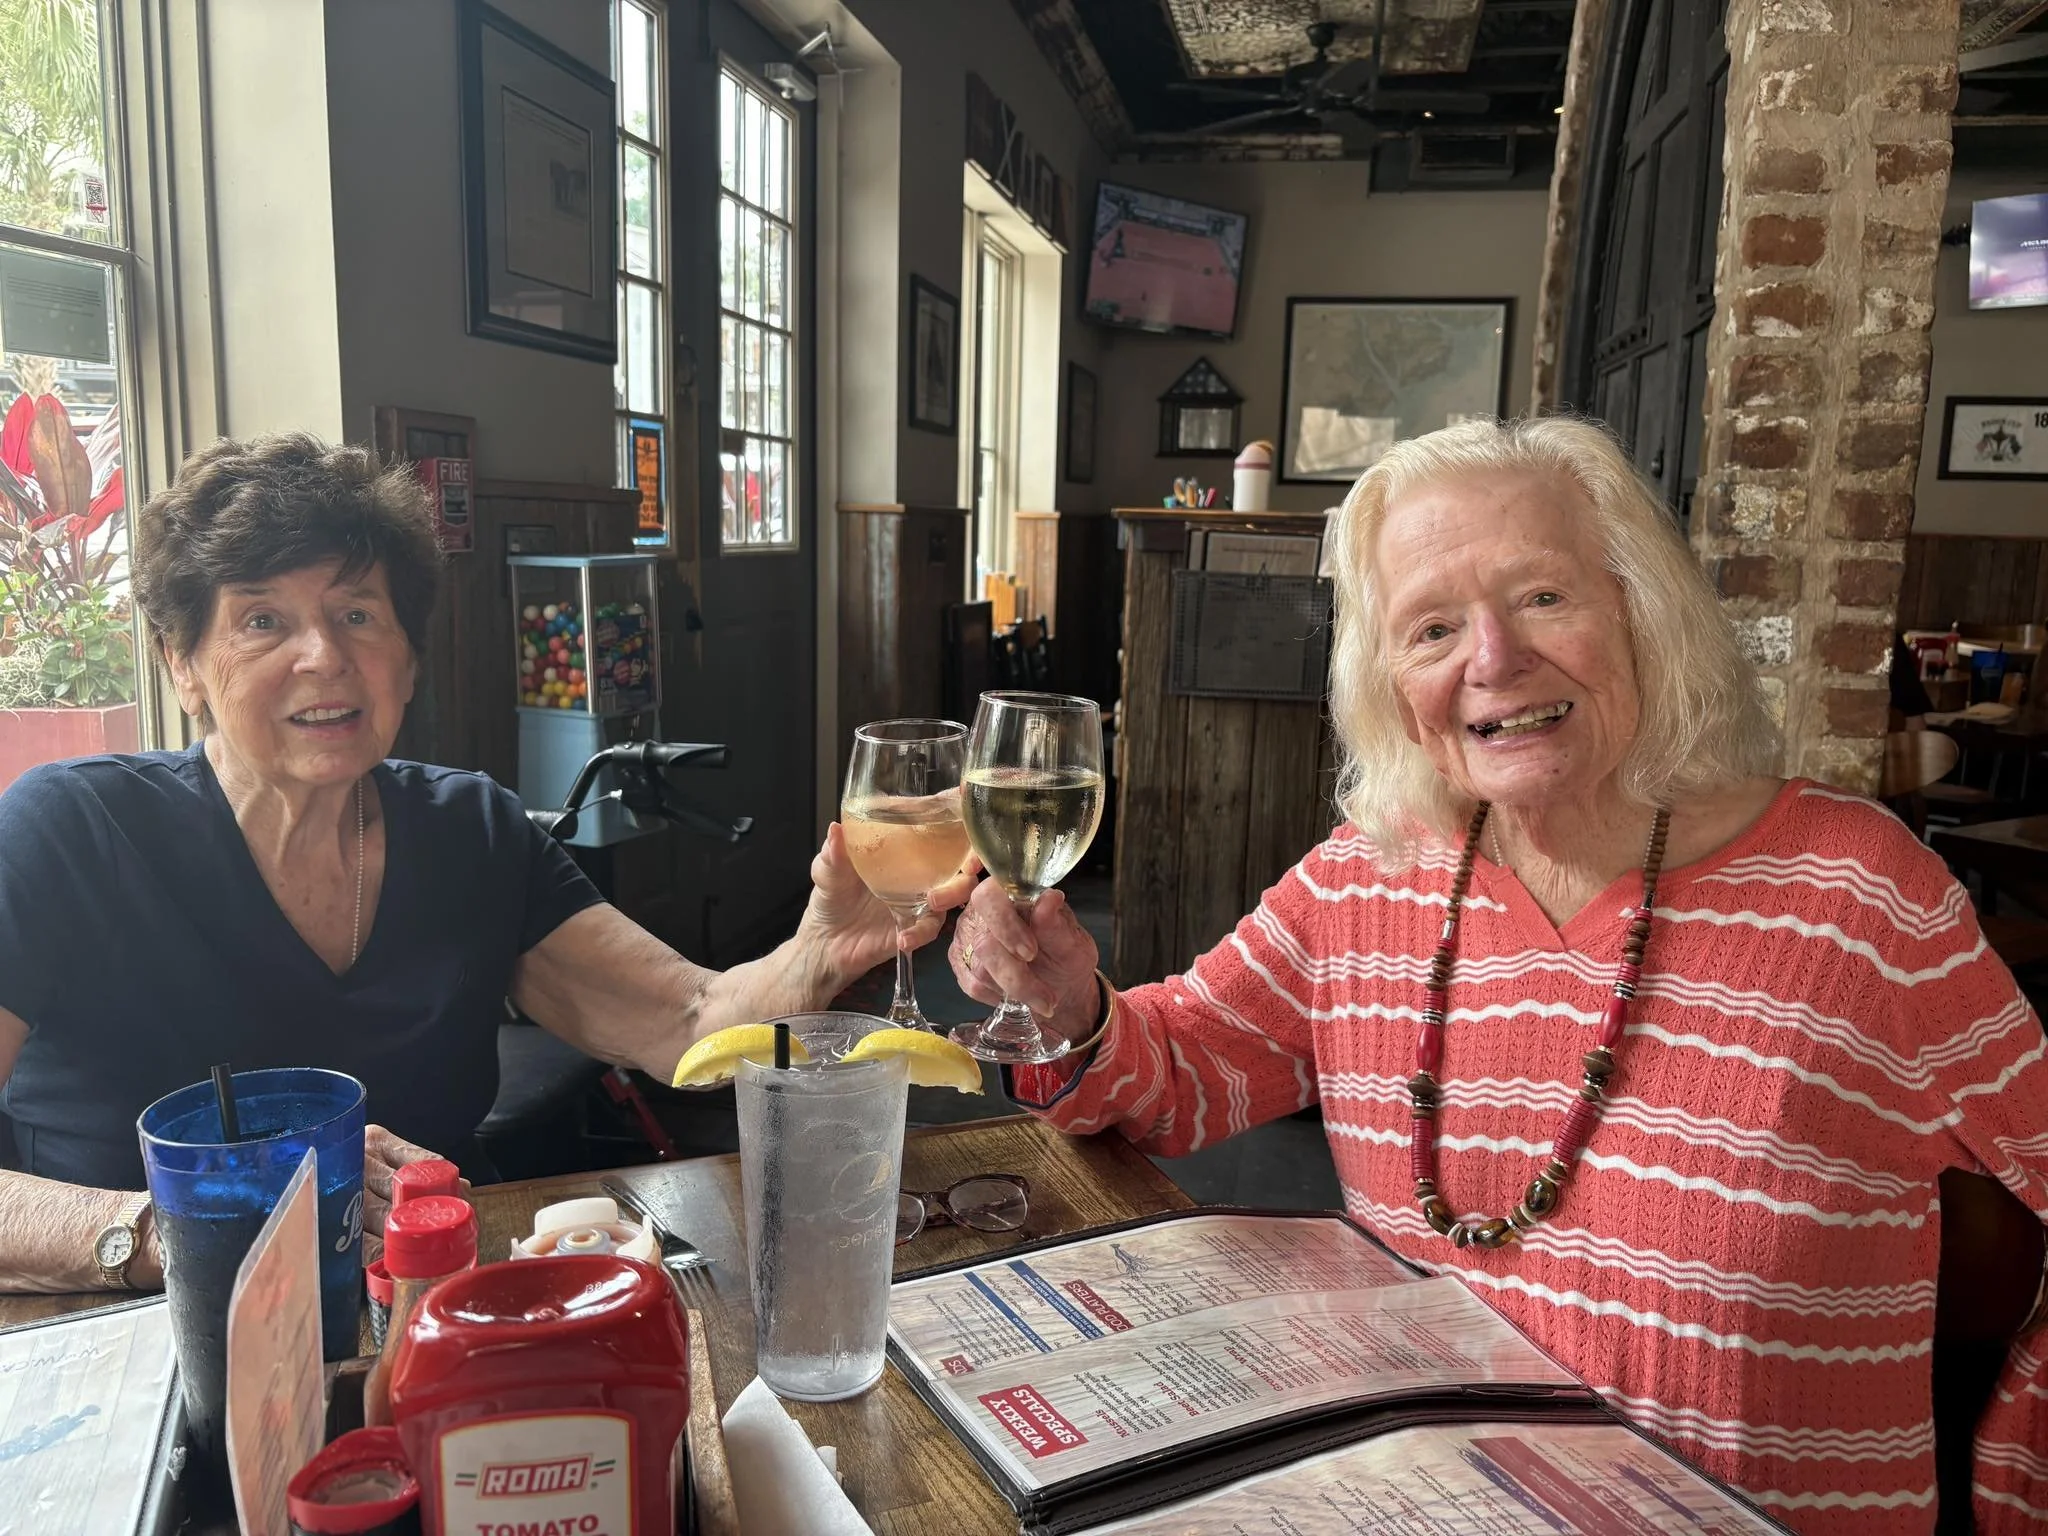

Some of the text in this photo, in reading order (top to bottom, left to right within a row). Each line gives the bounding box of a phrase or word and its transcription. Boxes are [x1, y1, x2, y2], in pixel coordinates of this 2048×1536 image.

[440, 462, 469, 481] FIRE
[1066, 1281, 1112, 1315] PLATTERS
[1011, 1316, 1026, 1327] SALAD
[1280, 1318, 1326, 1348] Tortellini
[1220, 1344, 1287, 1391] Grouper Wrap
[1287, 1334, 1349, 1377] Chicken with
[1319, 1348, 1364, 1375] Spinach
[1151, 1381, 1200, 1416] Beet Salad
[1182, 1391, 1207, 1408] medley
[1214, 1384, 1230, 1393] bed
[1099, 1399, 1123, 1416] mussels
[1205, 1398, 1221, 1409] with
[988, 1399, 1048, 1450] WEEKLY
[1012, 1388, 1079, 1445] SPECIALS
[1092, 1409, 1130, 1438] Mussels
[1144, 1413, 1164, 1427] bread
[485, 1458, 584, 1494] ROMA
[1393, 1499, 1417, 1517] Bites
[477, 1515, 599, 1536] TOMATO
[1411, 1516, 1435, 1532] Beef
